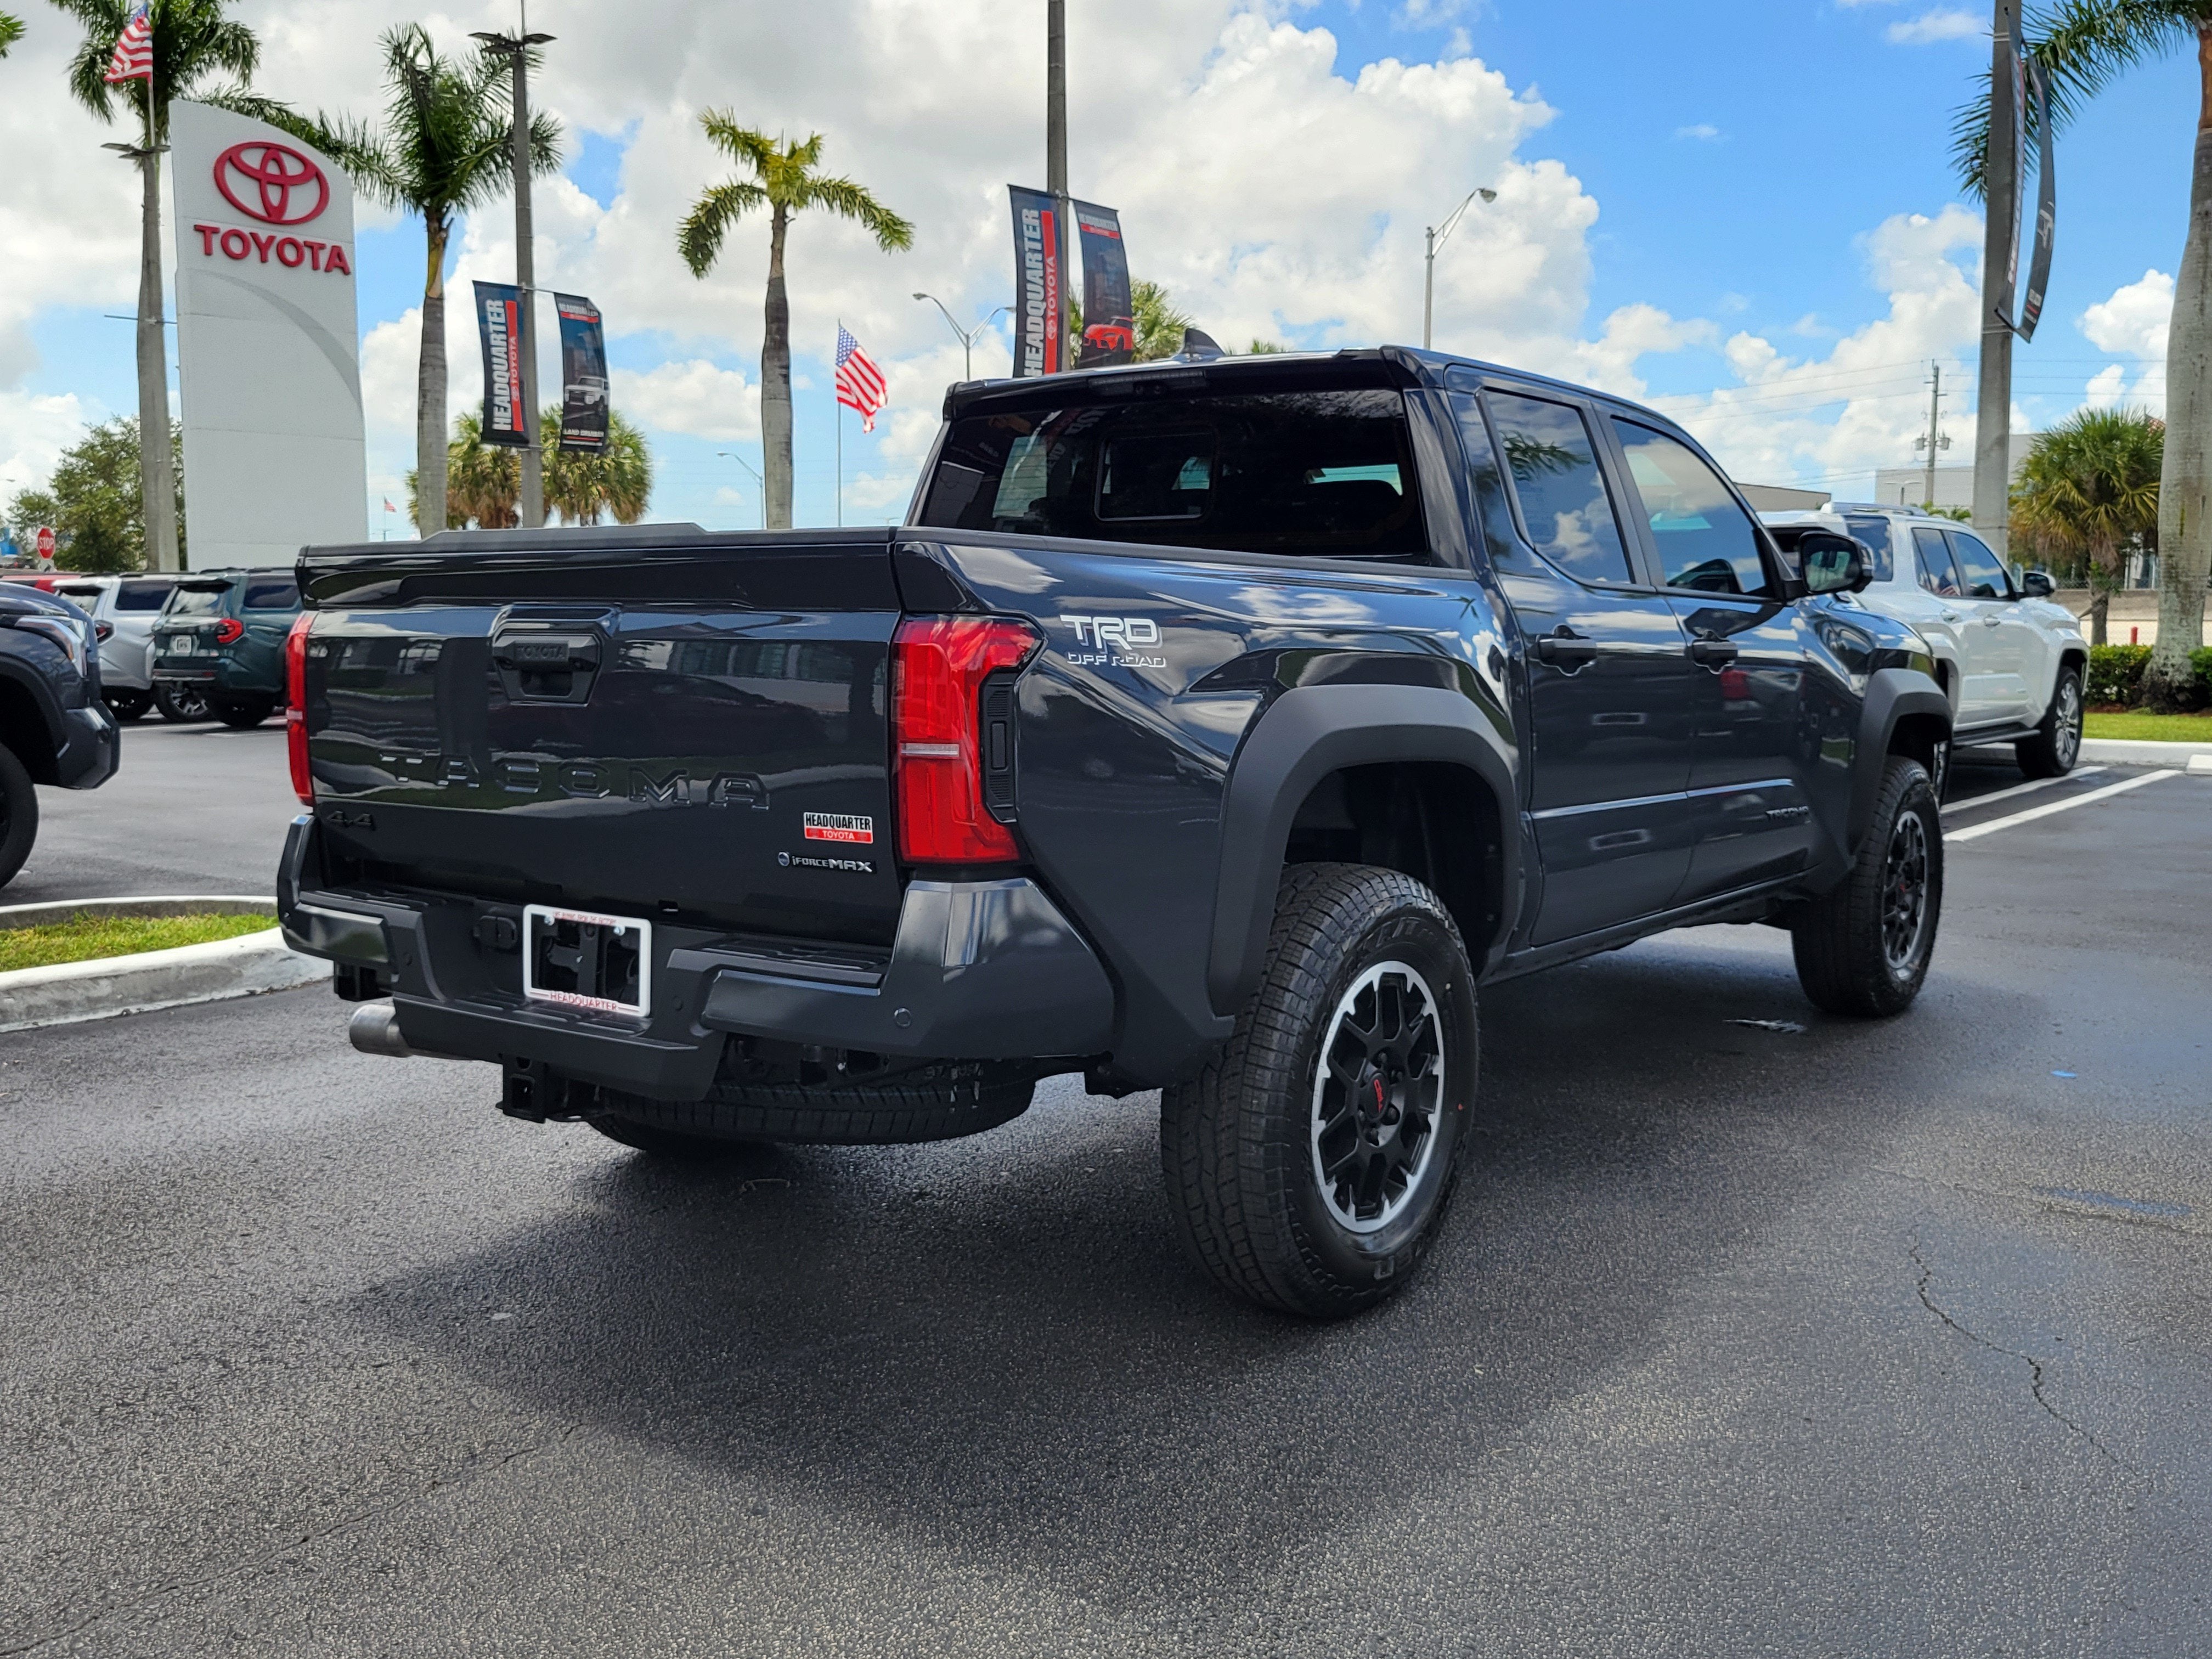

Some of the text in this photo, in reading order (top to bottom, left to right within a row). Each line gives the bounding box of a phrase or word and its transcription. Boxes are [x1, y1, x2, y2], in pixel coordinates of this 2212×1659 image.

[194, 224, 351, 275] TOYOTA
[1022, 207, 1046, 377] HEADQUARTER
[1045, 256, 1058, 312] TOYOTA
[486, 299, 512, 431] HEADQUARTER
[508, 336, 519, 383] TOYOTA
[38, 537, 54, 550] STOP
[516, 646, 565, 659] TOYOTA
[1059, 614, 1160, 651] TRD
[379, 748, 771, 811] TACOMA
[805, 814, 871, 830] HEADQUARTER
[823, 830, 855, 840] TOYOTA
[550, 992, 618, 1011] HEADQUARTER
